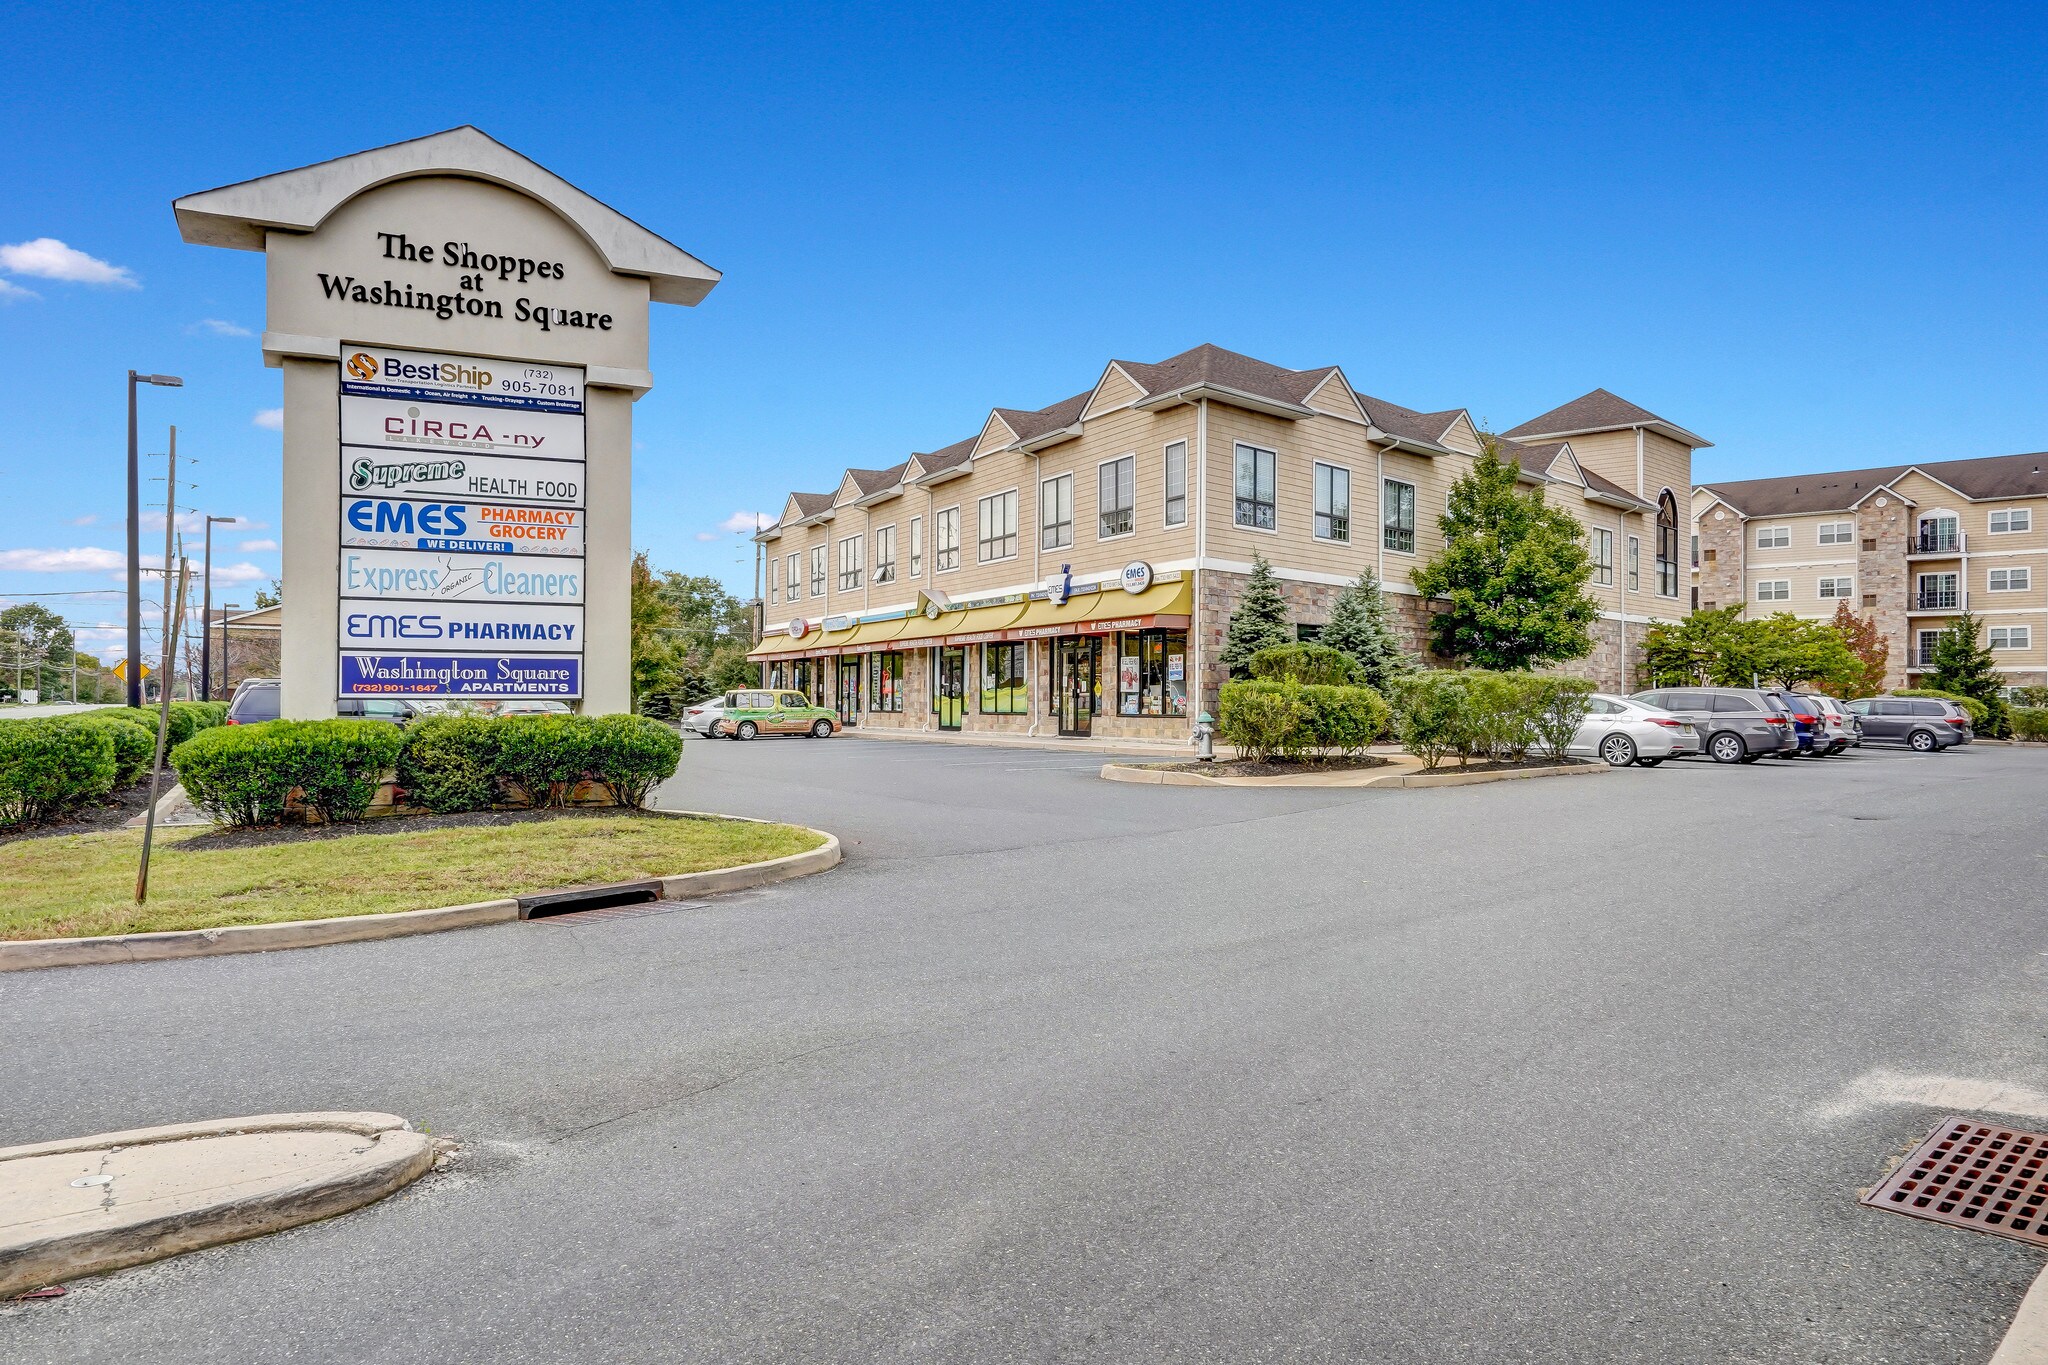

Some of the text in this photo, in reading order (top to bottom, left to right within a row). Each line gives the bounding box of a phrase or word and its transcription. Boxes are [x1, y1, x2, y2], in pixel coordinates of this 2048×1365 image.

[377, 231, 565, 283] The Shoppes
[460, 273, 484, 292] at
[317, 273, 613, 331] Washington Square
[384, 357, 493, 390] BestShip
[523, 368, 554, 381] (732)
[346, 383, 381, 392] International
[555, 401, 580, 409] Brokerage
[502, 379, 576, 397] 905-7081
[349, 456, 577, 498] Supreme HEALTH FOOD
[347, 500, 467, 536] EMES
[481, 507, 576, 525] PHARMACY
[489, 524, 568, 541] GROCERY
[426, 538, 506, 551] WE DELIVER!
[346, 555, 578, 597] Express ORGANIC Cleaners
[1125, 566, 1146, 580] EMES
[1048, 584, 1063, 594] EMES
[347, 613, 576, 641] EMES PHARMACY
[1035, 626, 1061, 636] PHARMACY
[1112, 618, 1142, 629] PHARMACY
[355, 656, 570, 684] Washington Square
[460, 682, 570, 693] APARTMENTS
